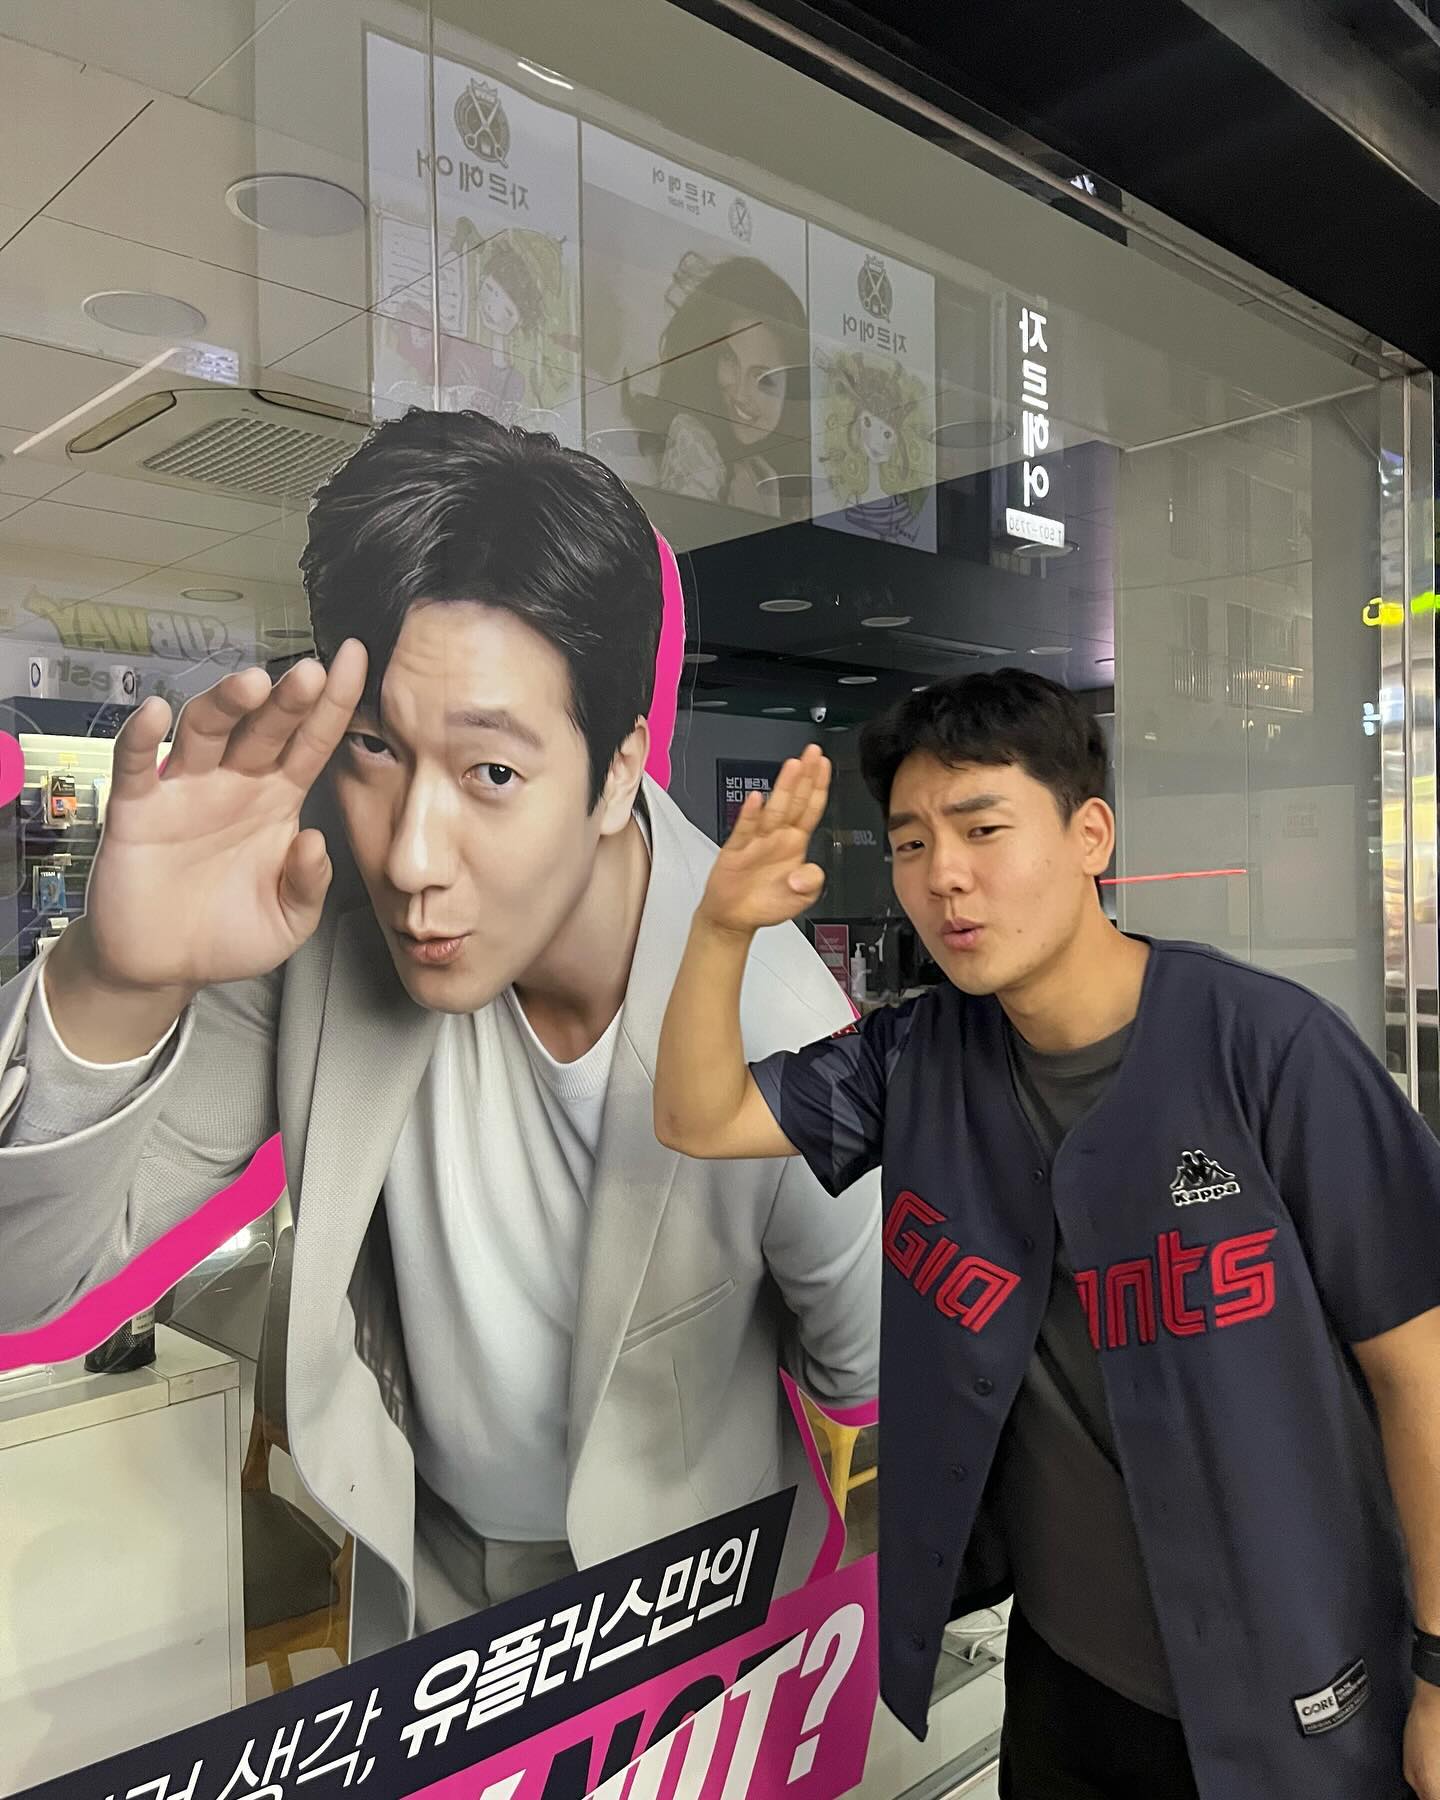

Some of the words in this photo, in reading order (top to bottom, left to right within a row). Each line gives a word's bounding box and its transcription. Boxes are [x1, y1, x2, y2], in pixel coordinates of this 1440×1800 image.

[726, 776, 743, 789] 보다
[726, 790, 743, 802] 보다
[1172, 1182, 1240, 1206] Kappa
[399, 1528, 760, 1759] 유플러스만의
[1302, 1695, 1335, 1716] CORE
